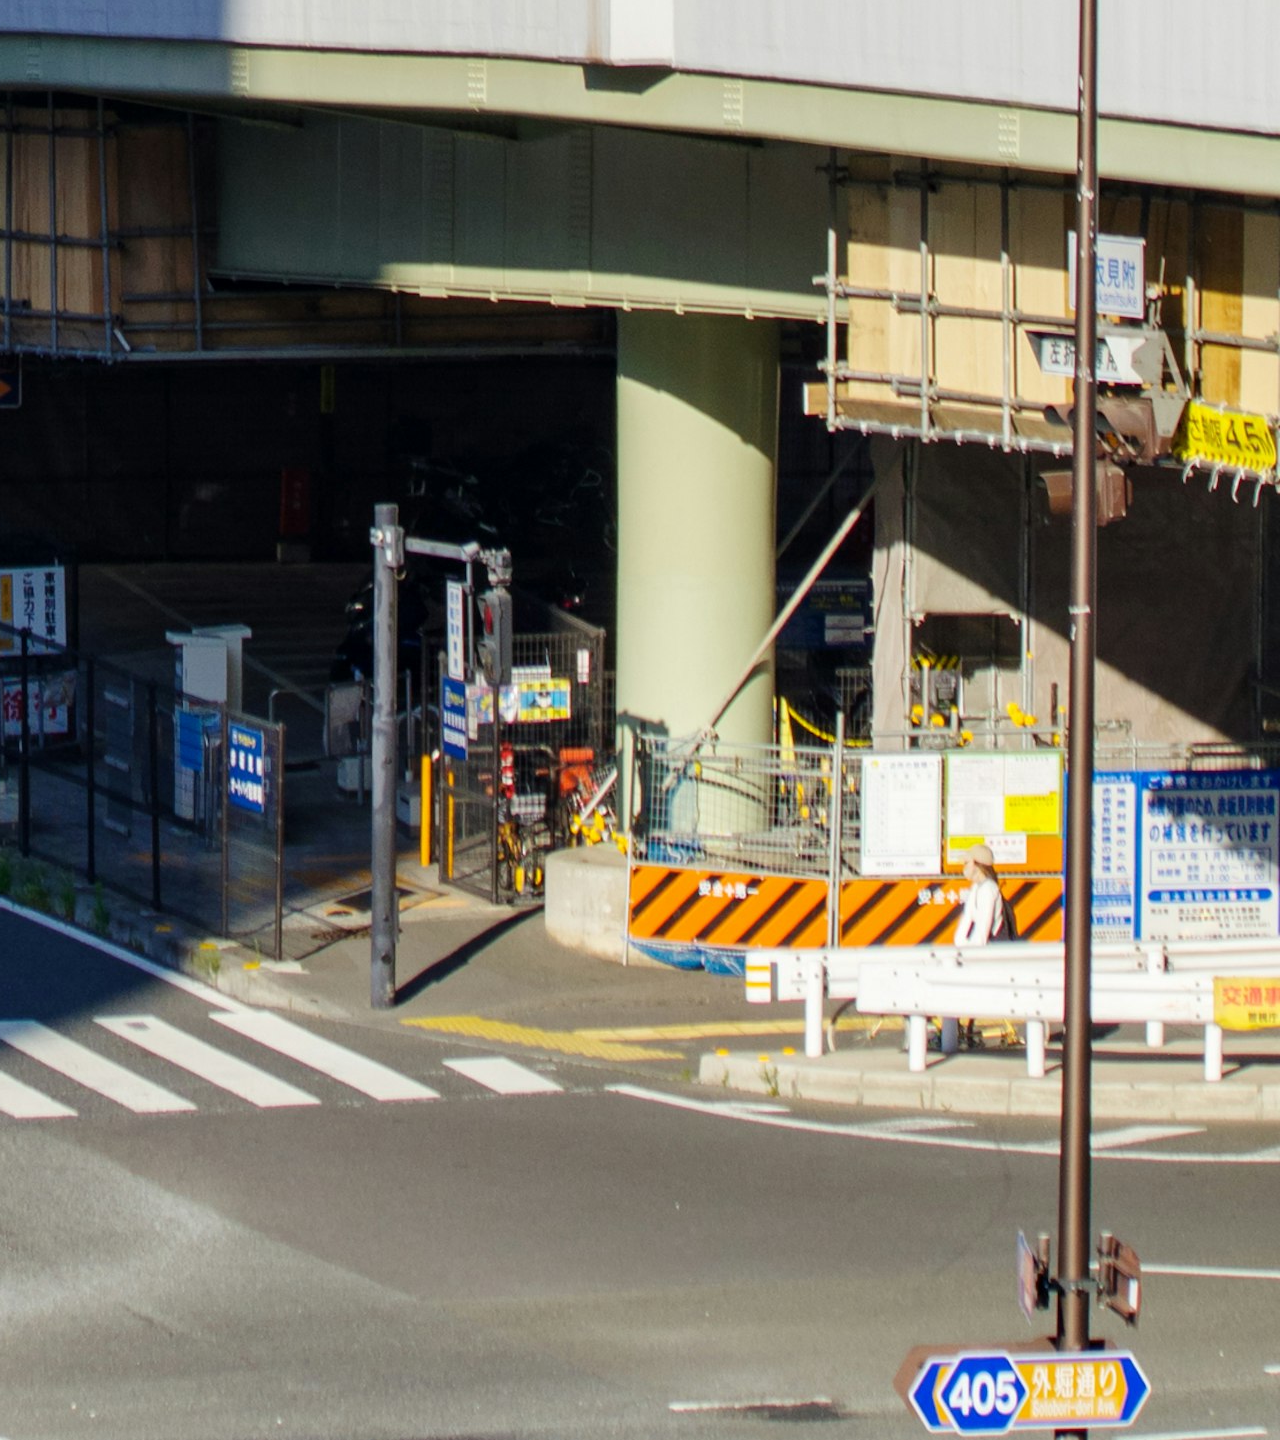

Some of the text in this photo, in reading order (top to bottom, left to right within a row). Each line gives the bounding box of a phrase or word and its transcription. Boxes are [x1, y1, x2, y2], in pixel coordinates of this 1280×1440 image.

[948, 1370, 1020, 1417] 405
[1032, 1364, 1118, 1399] 外堀通り
